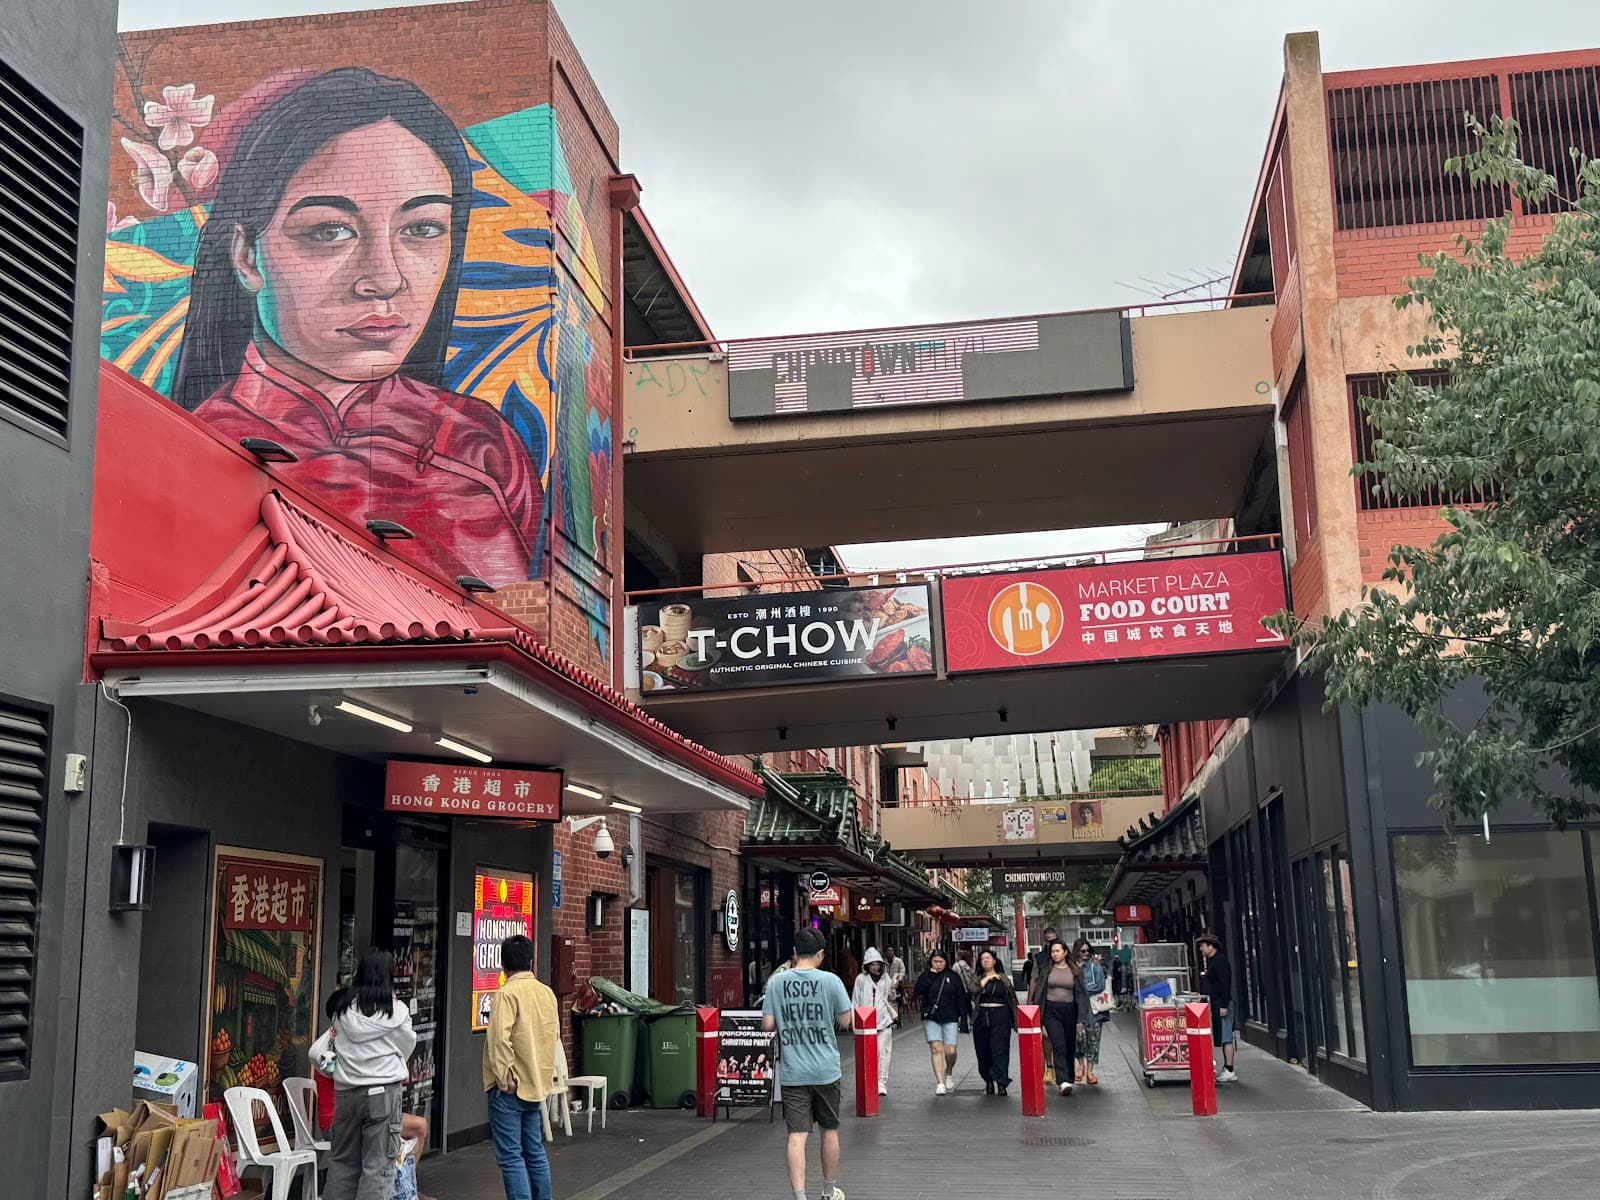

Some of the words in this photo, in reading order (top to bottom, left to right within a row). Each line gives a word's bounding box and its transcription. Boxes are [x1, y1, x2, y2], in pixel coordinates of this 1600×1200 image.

[1078, 576, 1160, 599] MARKET
[1165, 571, 1230, 592] PLAZA
[727, 612, 749, 620] ESTD
[1079, 599, 1146, 622] FOOD
[1150, 592, 1231, 616] COURT
[687, 618, 881, 662] T-CHOW
[1081, 620, 1233, 645] 中国城饮食天地
[710, 665, 754, 674] AUTHENTIC
[755, 663, 793, 671] ORIGINAL
[793, 660, 829, 668] CHINESE
[829, 658, 863, 666] CUISINE
[422, 773, 531, 799] 香港超市
[391, 795, 433, 807] HONG
[440, 797, 482, 810] KONG
[487, 800, 555, 814] GROCERY
[230, 874, 306, 925] 香港超市
[781, 1002, 824, 1022] NEVER
[782, 1026, 805, 1046] SAY
[807, 1027, 828, 1045] DIE
